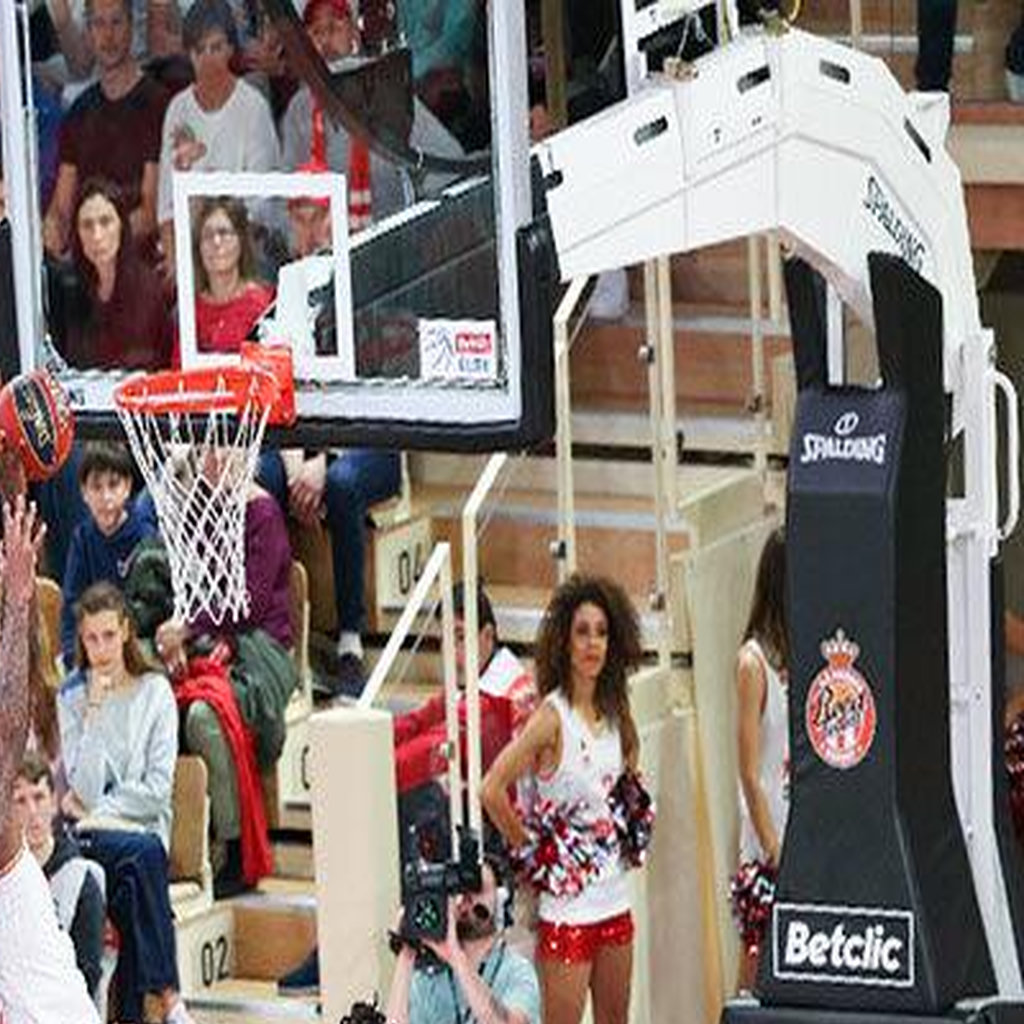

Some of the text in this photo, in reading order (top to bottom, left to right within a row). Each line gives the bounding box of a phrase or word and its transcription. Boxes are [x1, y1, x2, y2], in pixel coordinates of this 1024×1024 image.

[800, 433, 887, 465] SPALDING
[200, 936, 229, 987] 02
[785, 919, 903, 972] Betclic
